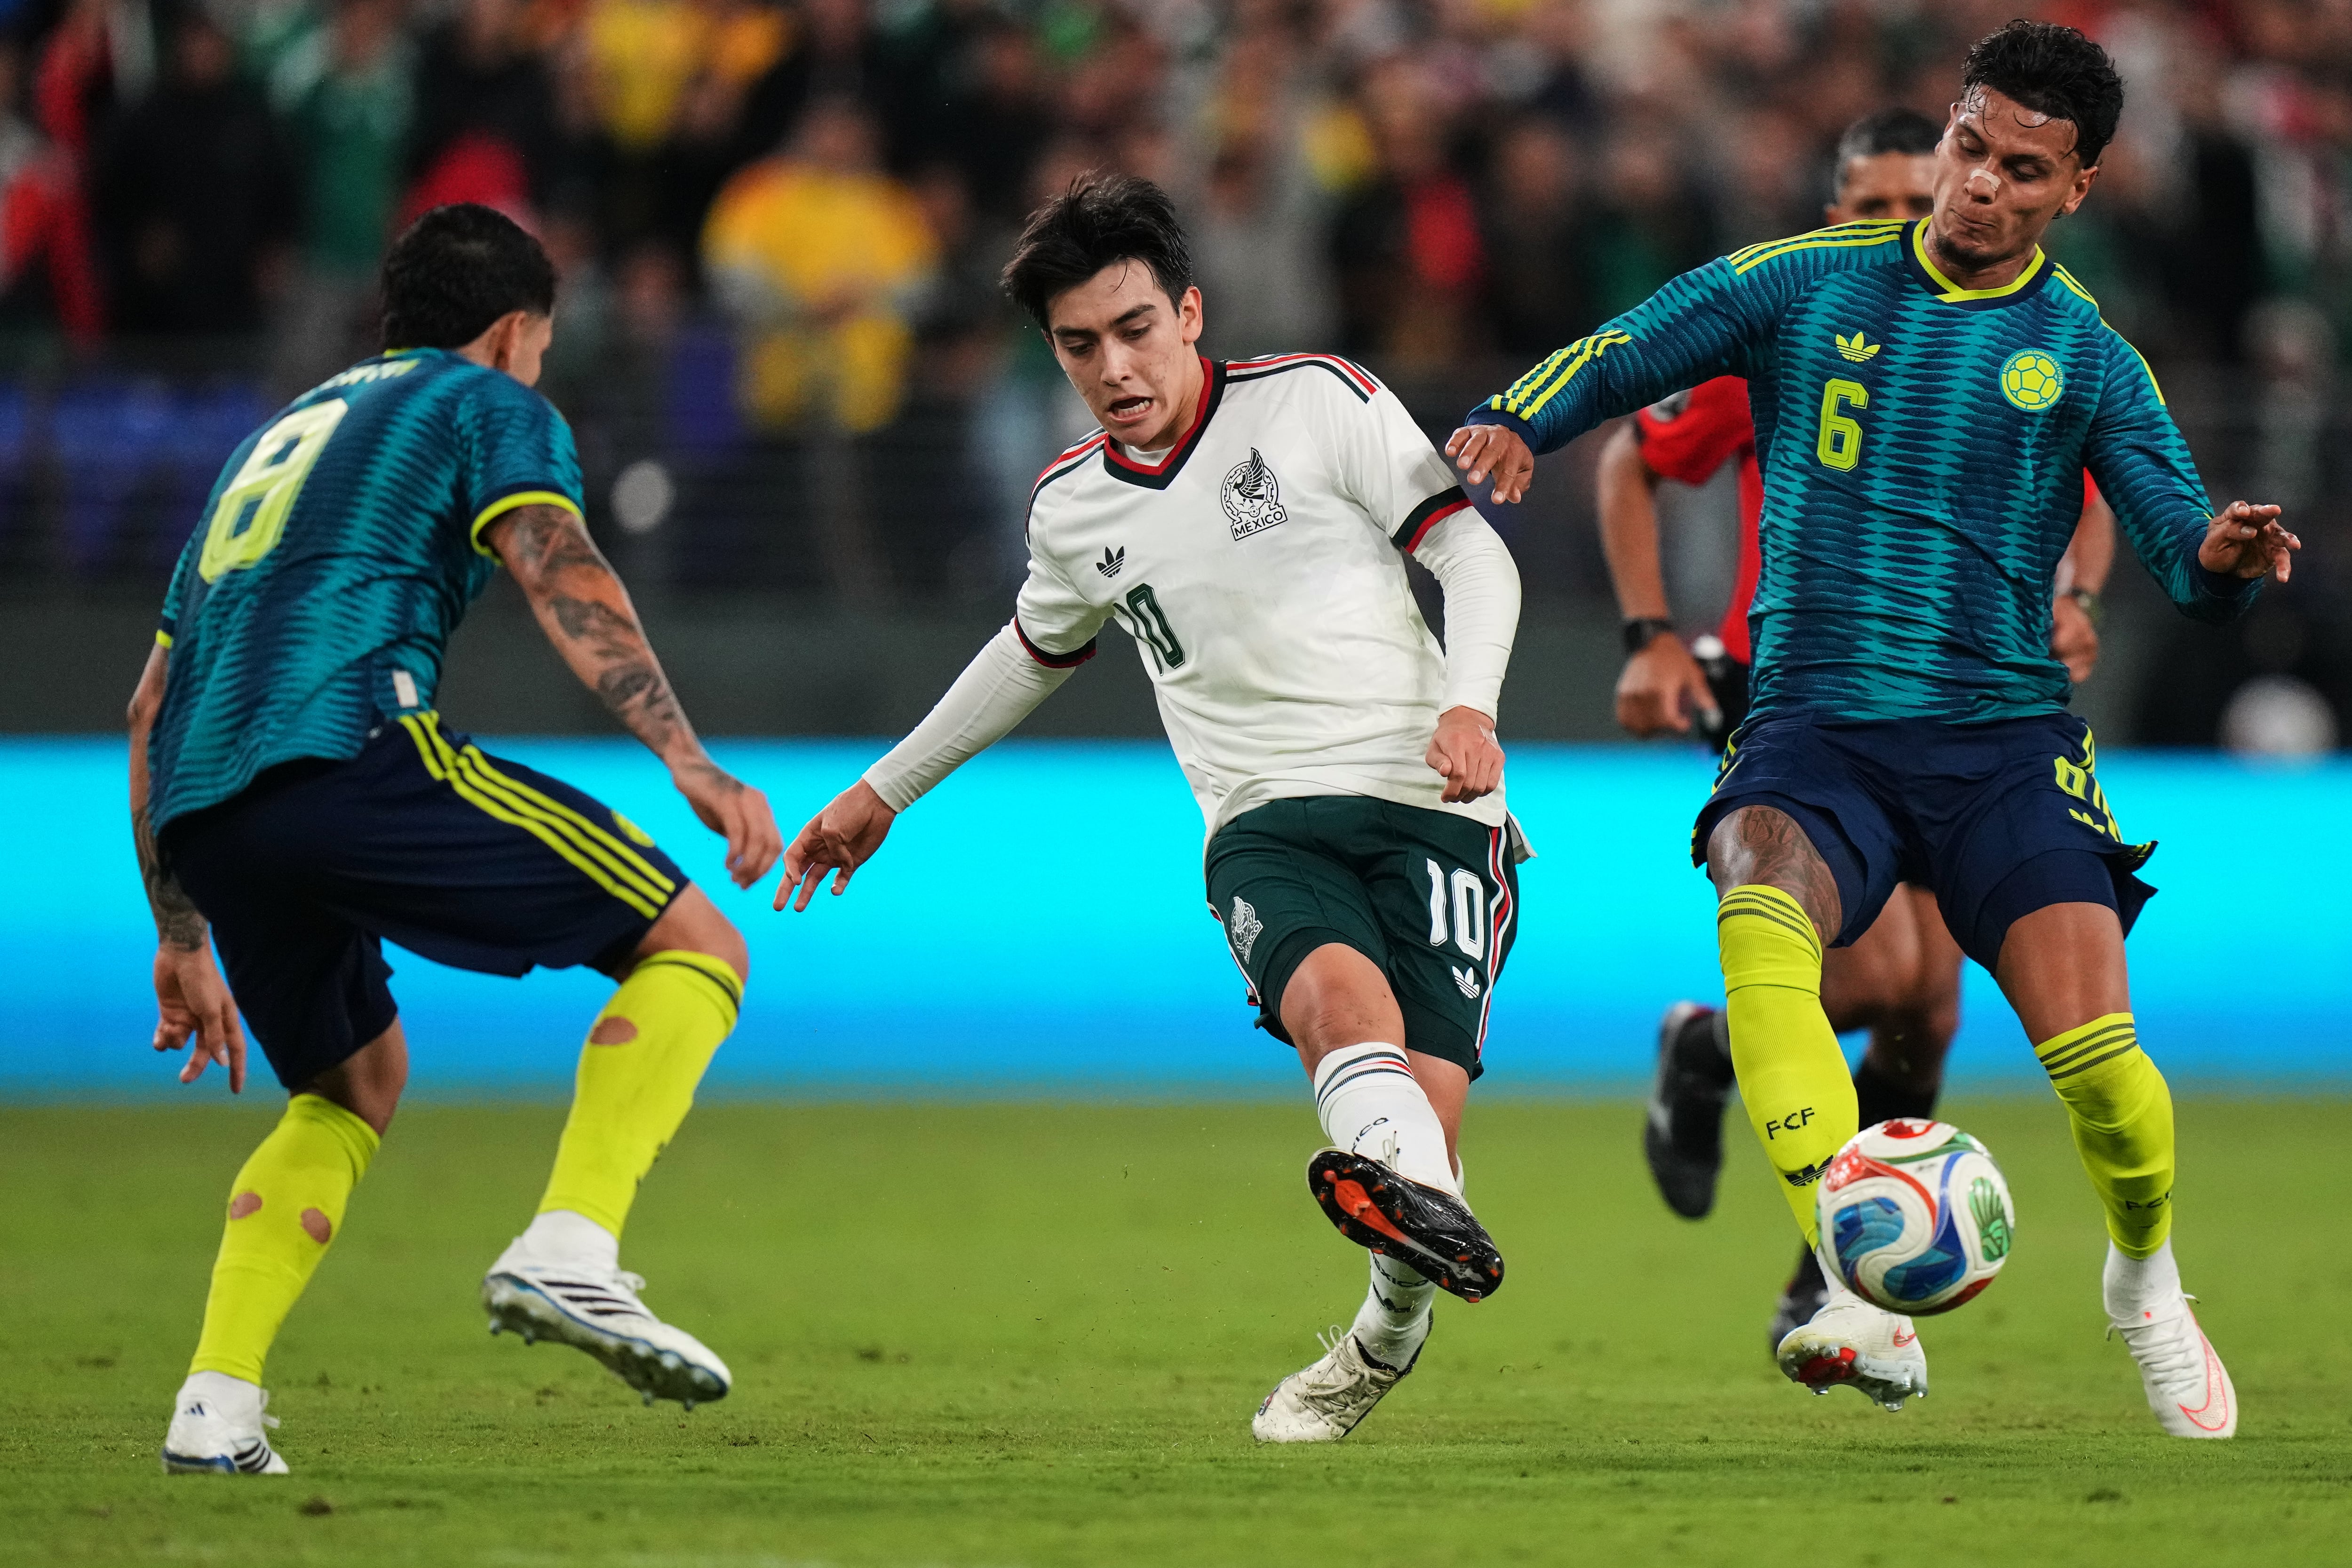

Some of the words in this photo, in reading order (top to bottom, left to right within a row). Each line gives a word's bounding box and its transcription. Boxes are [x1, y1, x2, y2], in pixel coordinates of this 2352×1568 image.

[1817, 378, 1869, 472] 6
[198, 398, 349, 584] 8
[1234, 511, 1283, 537] MÉXICO
[1426, 858, 1485, 962] 10
[1766, 1107, 1815, 1140] FCF
